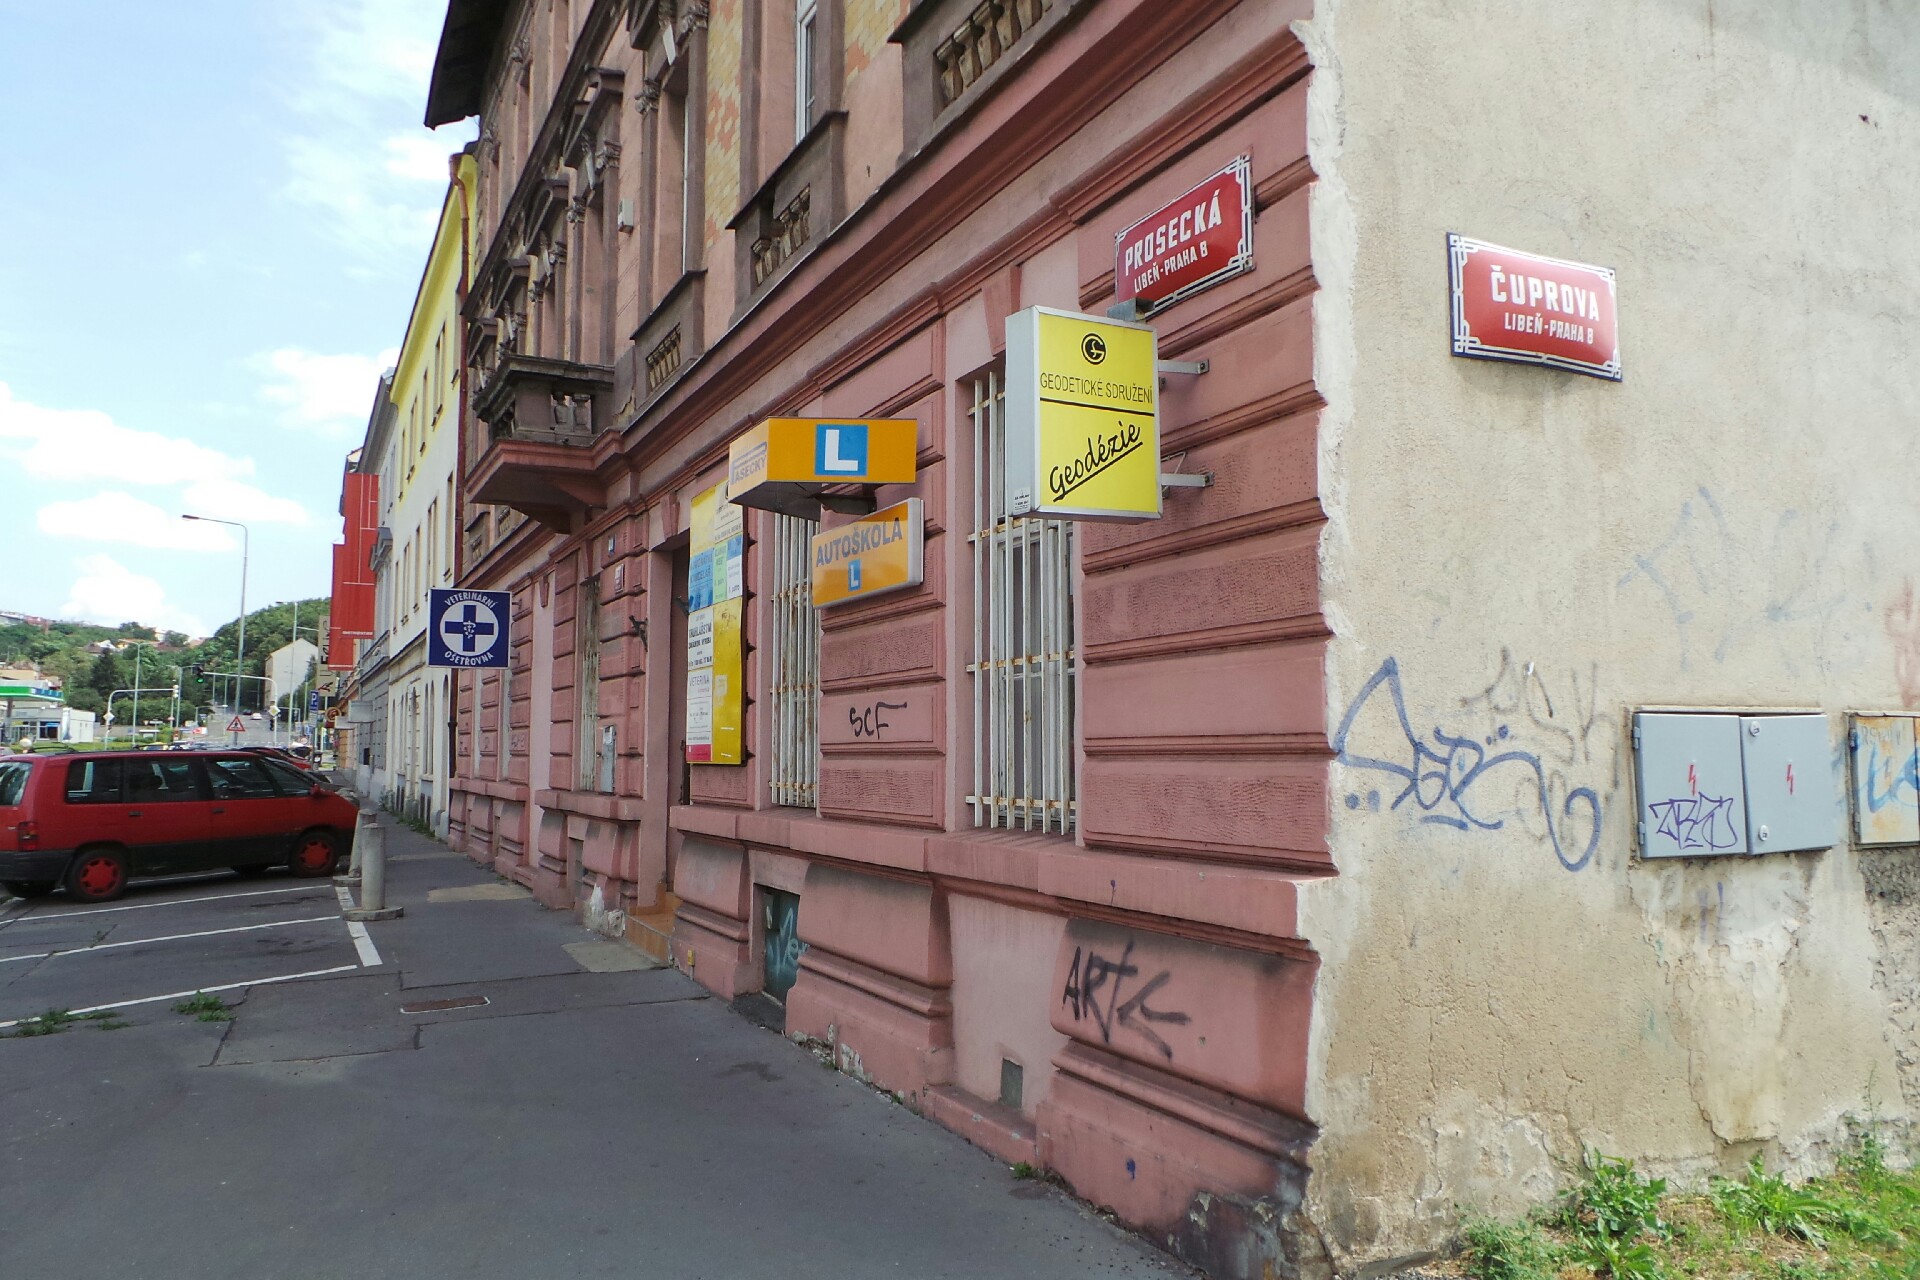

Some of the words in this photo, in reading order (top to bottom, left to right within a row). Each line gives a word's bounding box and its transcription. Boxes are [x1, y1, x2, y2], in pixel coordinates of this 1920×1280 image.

[1125, 189, 1222, 276] PROSECKÁ
[1199, 240, 1208, 258] 8
[1490, 265, 1600, 321] ČUPROVA
[1586, 327, 1594, 345] 8
[1040, 371, 1104, 397] GEODETICKÉ
[1105, 382, 1153, 404] SDRUŽENÍ
[824, 429, 858, 471] L
[1049, 420, 1141, 500] Geodézie
[816, 517, 902, 567] AUTOŠKOLA
[850, 564, 859, 588] L
[444, 592, 498, 609] VETERINÁRNÍ
[444, 651, 494, 666] OŠETŘOVNA
